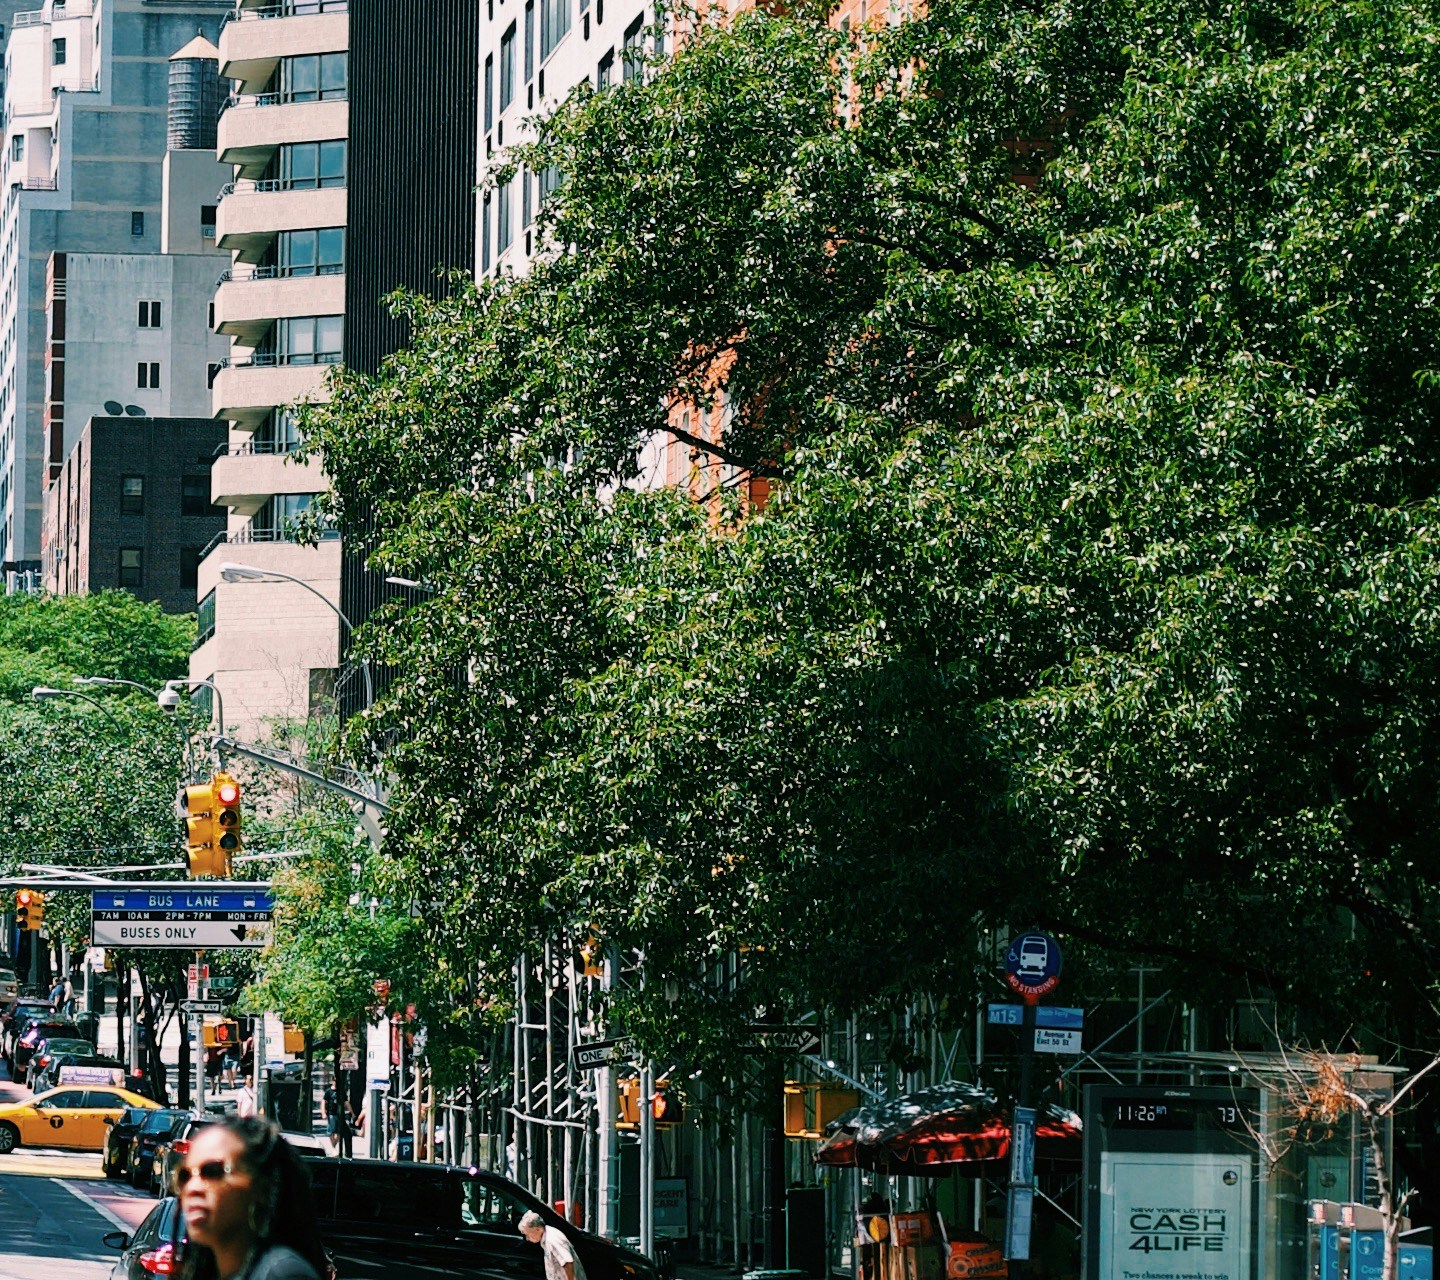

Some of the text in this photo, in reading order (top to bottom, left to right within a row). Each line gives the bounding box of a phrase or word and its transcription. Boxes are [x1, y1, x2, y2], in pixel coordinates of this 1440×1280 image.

[148, 895, 220, 907] BUS LANE
[100, 911, 120, 920] 7AM
[127, 911, 150, 920] 10AM
[165, 912, 185, 920] 2PM
[192, 912, 212, 920] 7PM
[227, 912, 246, 921] MON
[120, 927, 197, 939] BUSES ONLY
[1008, 974, 1056, 995] NO STANDING
[989, 1009, 1017, 1024] M15
[580, 1049, 604, 1063] ONE
[402, 1145, 411, 1156] P
[1129, 1213, 1226, 1232] CASH
[1128, 1235, 1224, 1254] 4LIFE
[1123, 1271, 1141, 1280] Two
[1141, 1271, 1174, 1280] chances
[1181, 1272, 1203, 1280] week
[1214, 1272, 1229, 1280] win
